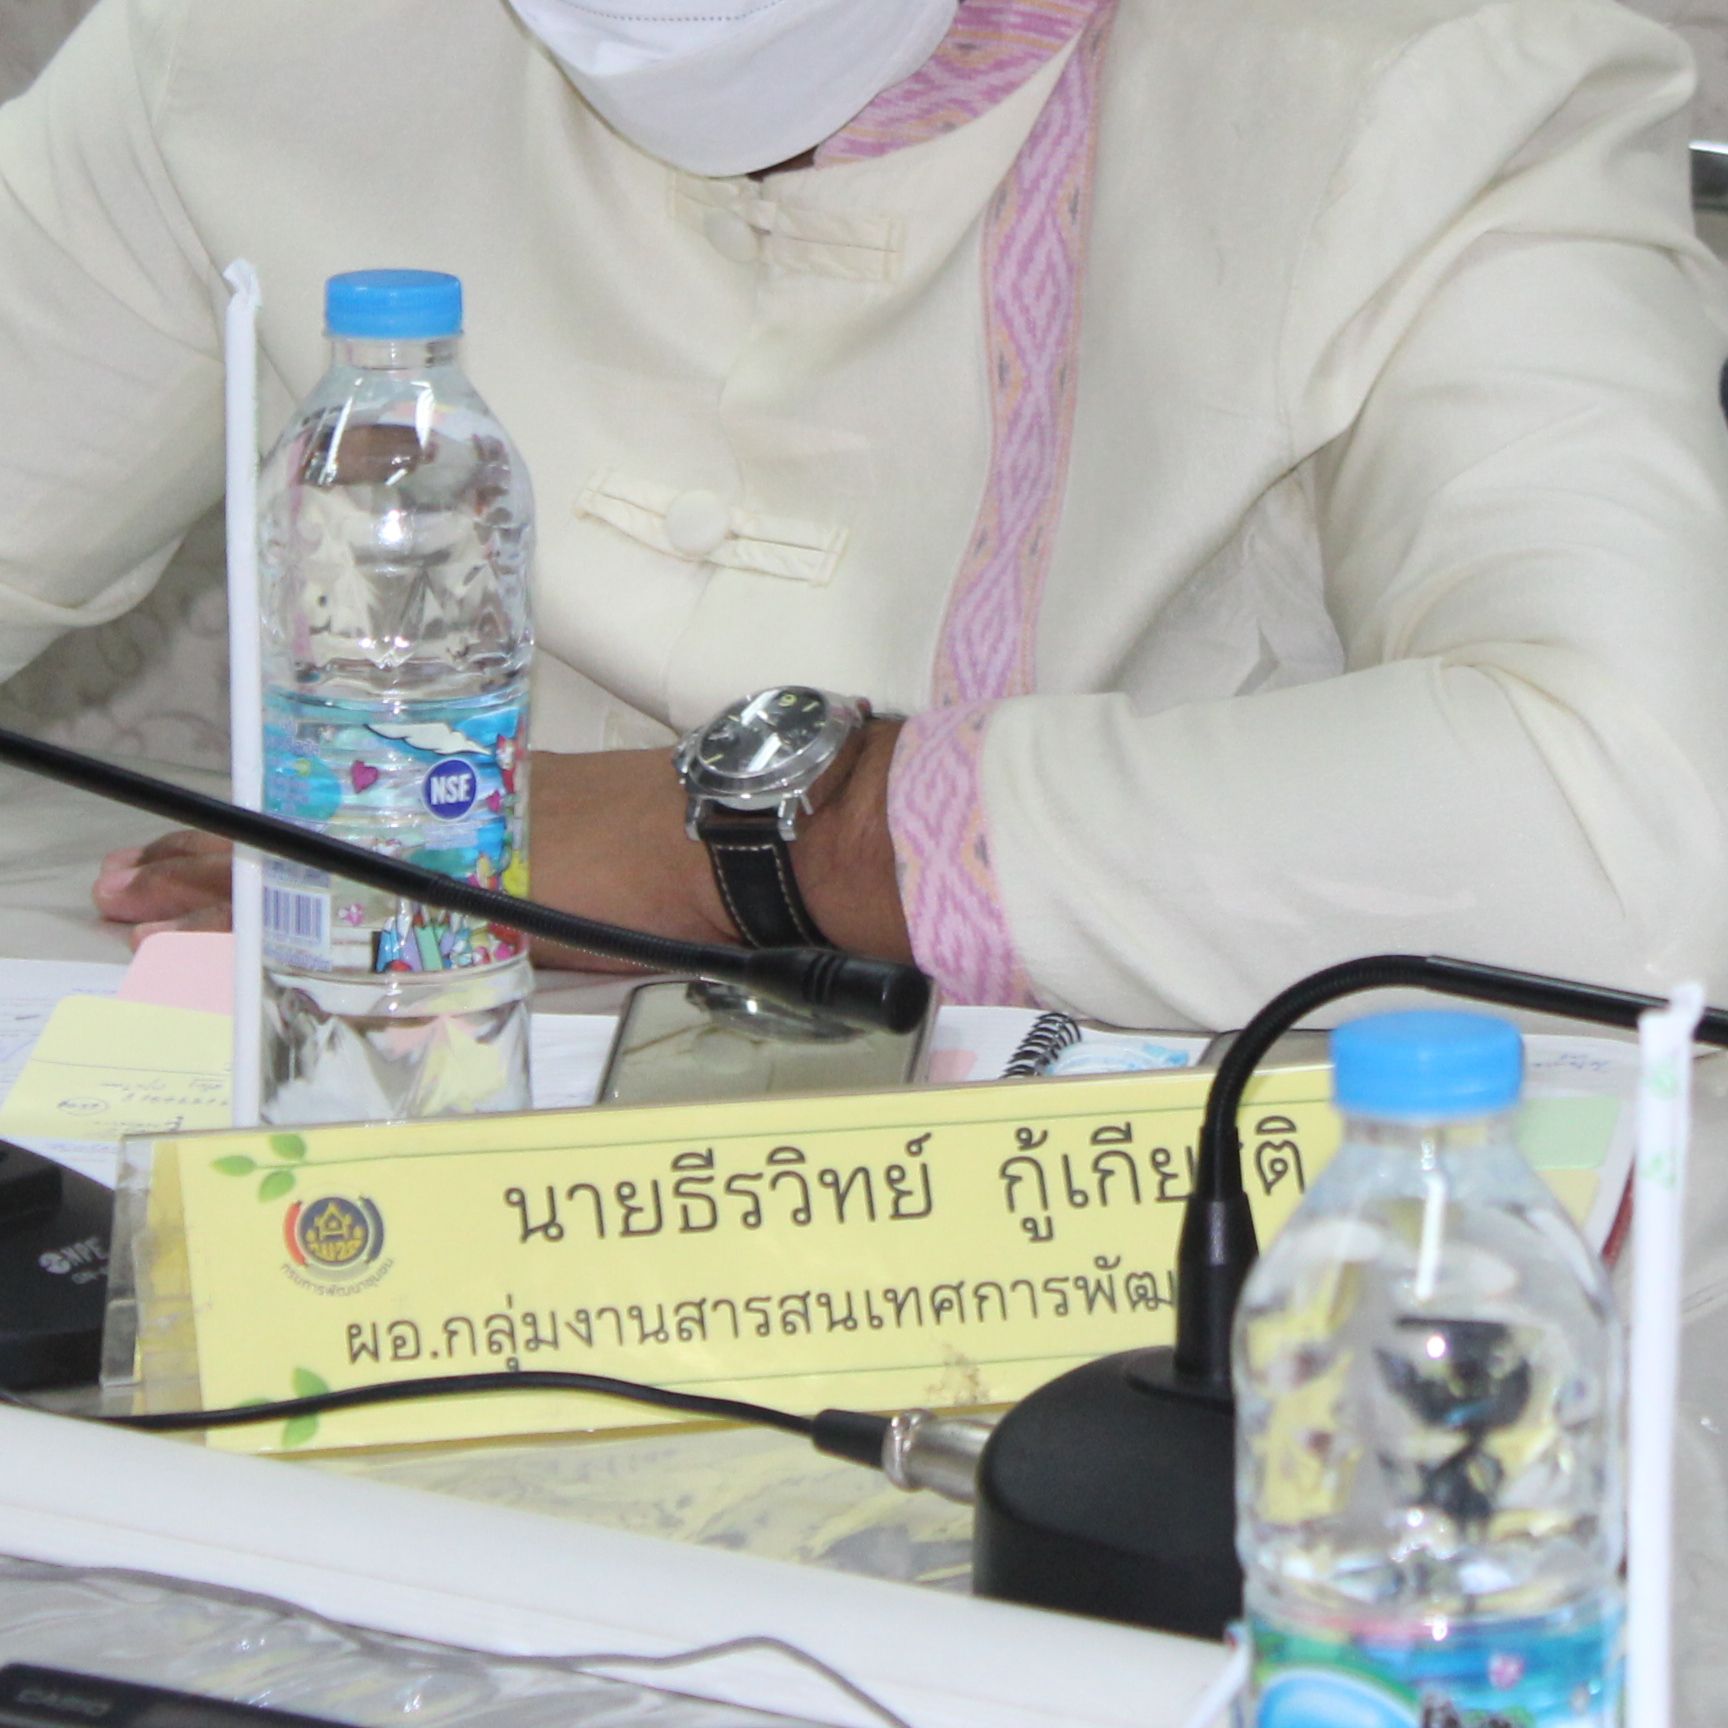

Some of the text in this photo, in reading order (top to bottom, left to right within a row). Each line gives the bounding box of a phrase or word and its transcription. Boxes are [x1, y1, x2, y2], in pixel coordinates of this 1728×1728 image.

[430, 773, 472, 806] NSF
[503, 1114, 1306, 1244] นายธีรวิทย์ กู้เกียติ
